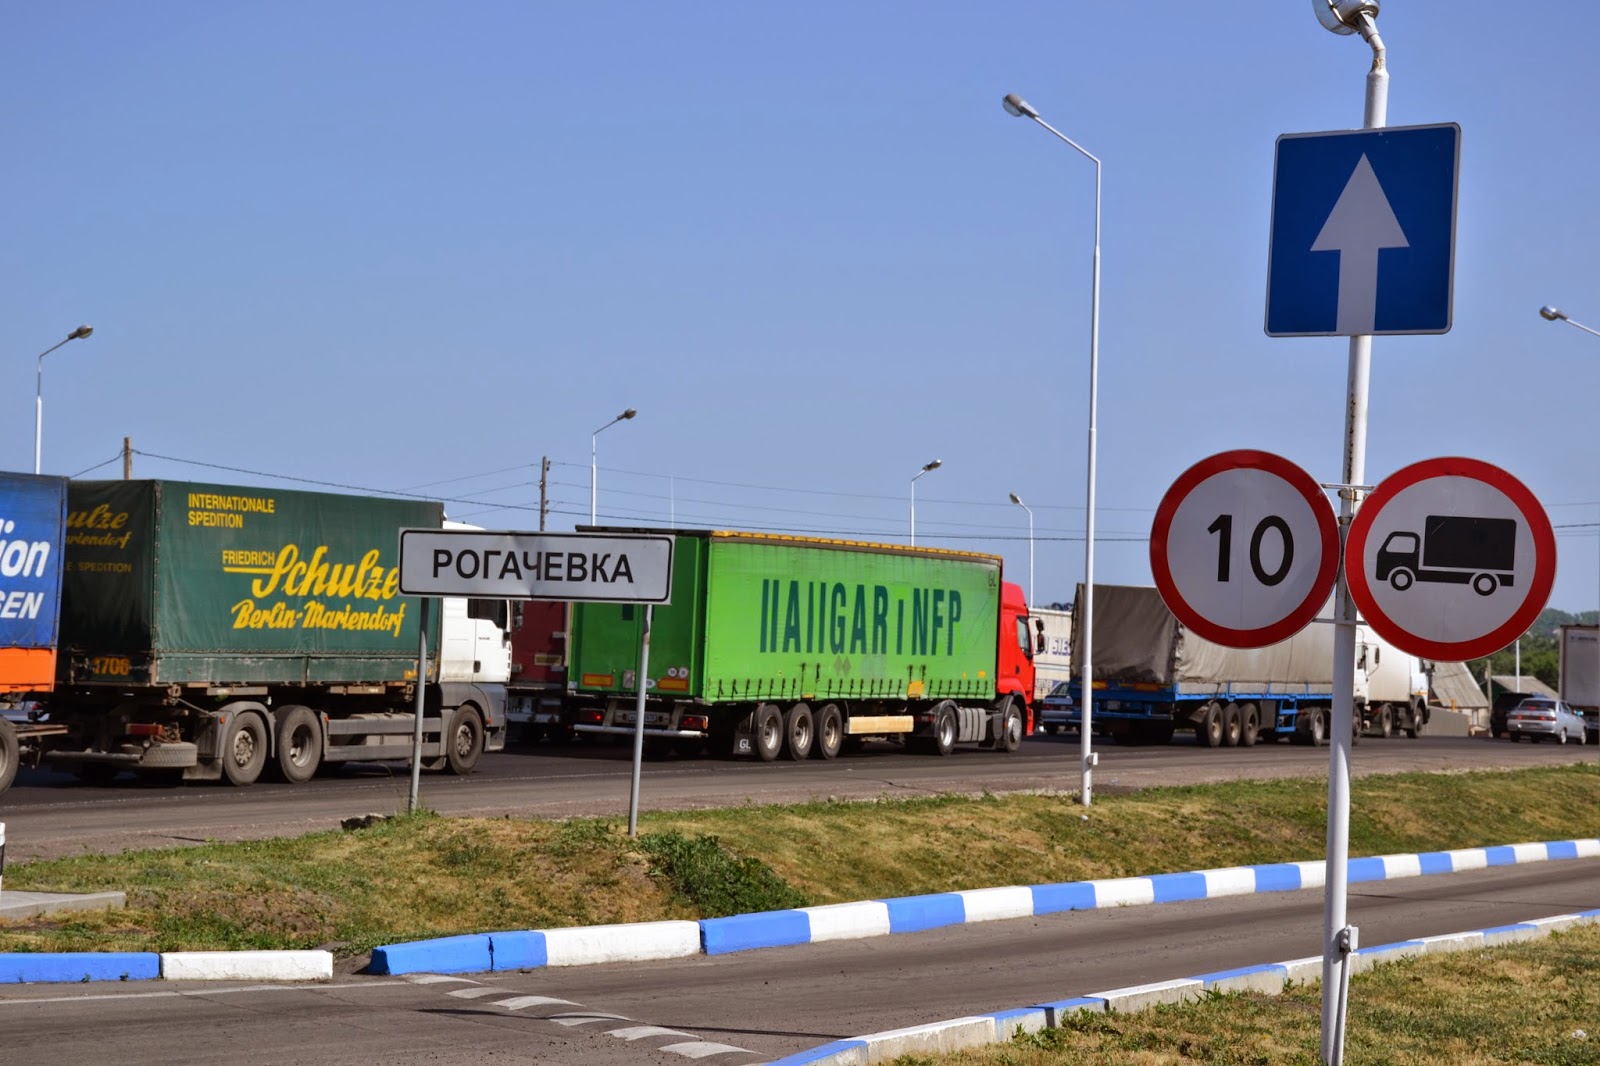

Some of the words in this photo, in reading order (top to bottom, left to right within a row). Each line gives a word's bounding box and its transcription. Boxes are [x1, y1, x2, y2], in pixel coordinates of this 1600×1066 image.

[188, 493, 275, 513] INTERNATIONALE
[188, 511, 243, 528] SPEDITION
[0, 518, 50, 577] ion
[1207, 514, 1294, 586] 10
[78, 561, 132, 573] SPEDITION
[222, 549, 275, 566] FRIEDRICH
[251, 543, 398, 600] Schulze
[432, 549, 634, 583] РОГАЧЕВКА
[231, 599, 406, 637] Berlin-Mariendorf
[739, 738, 751, 749] GL
